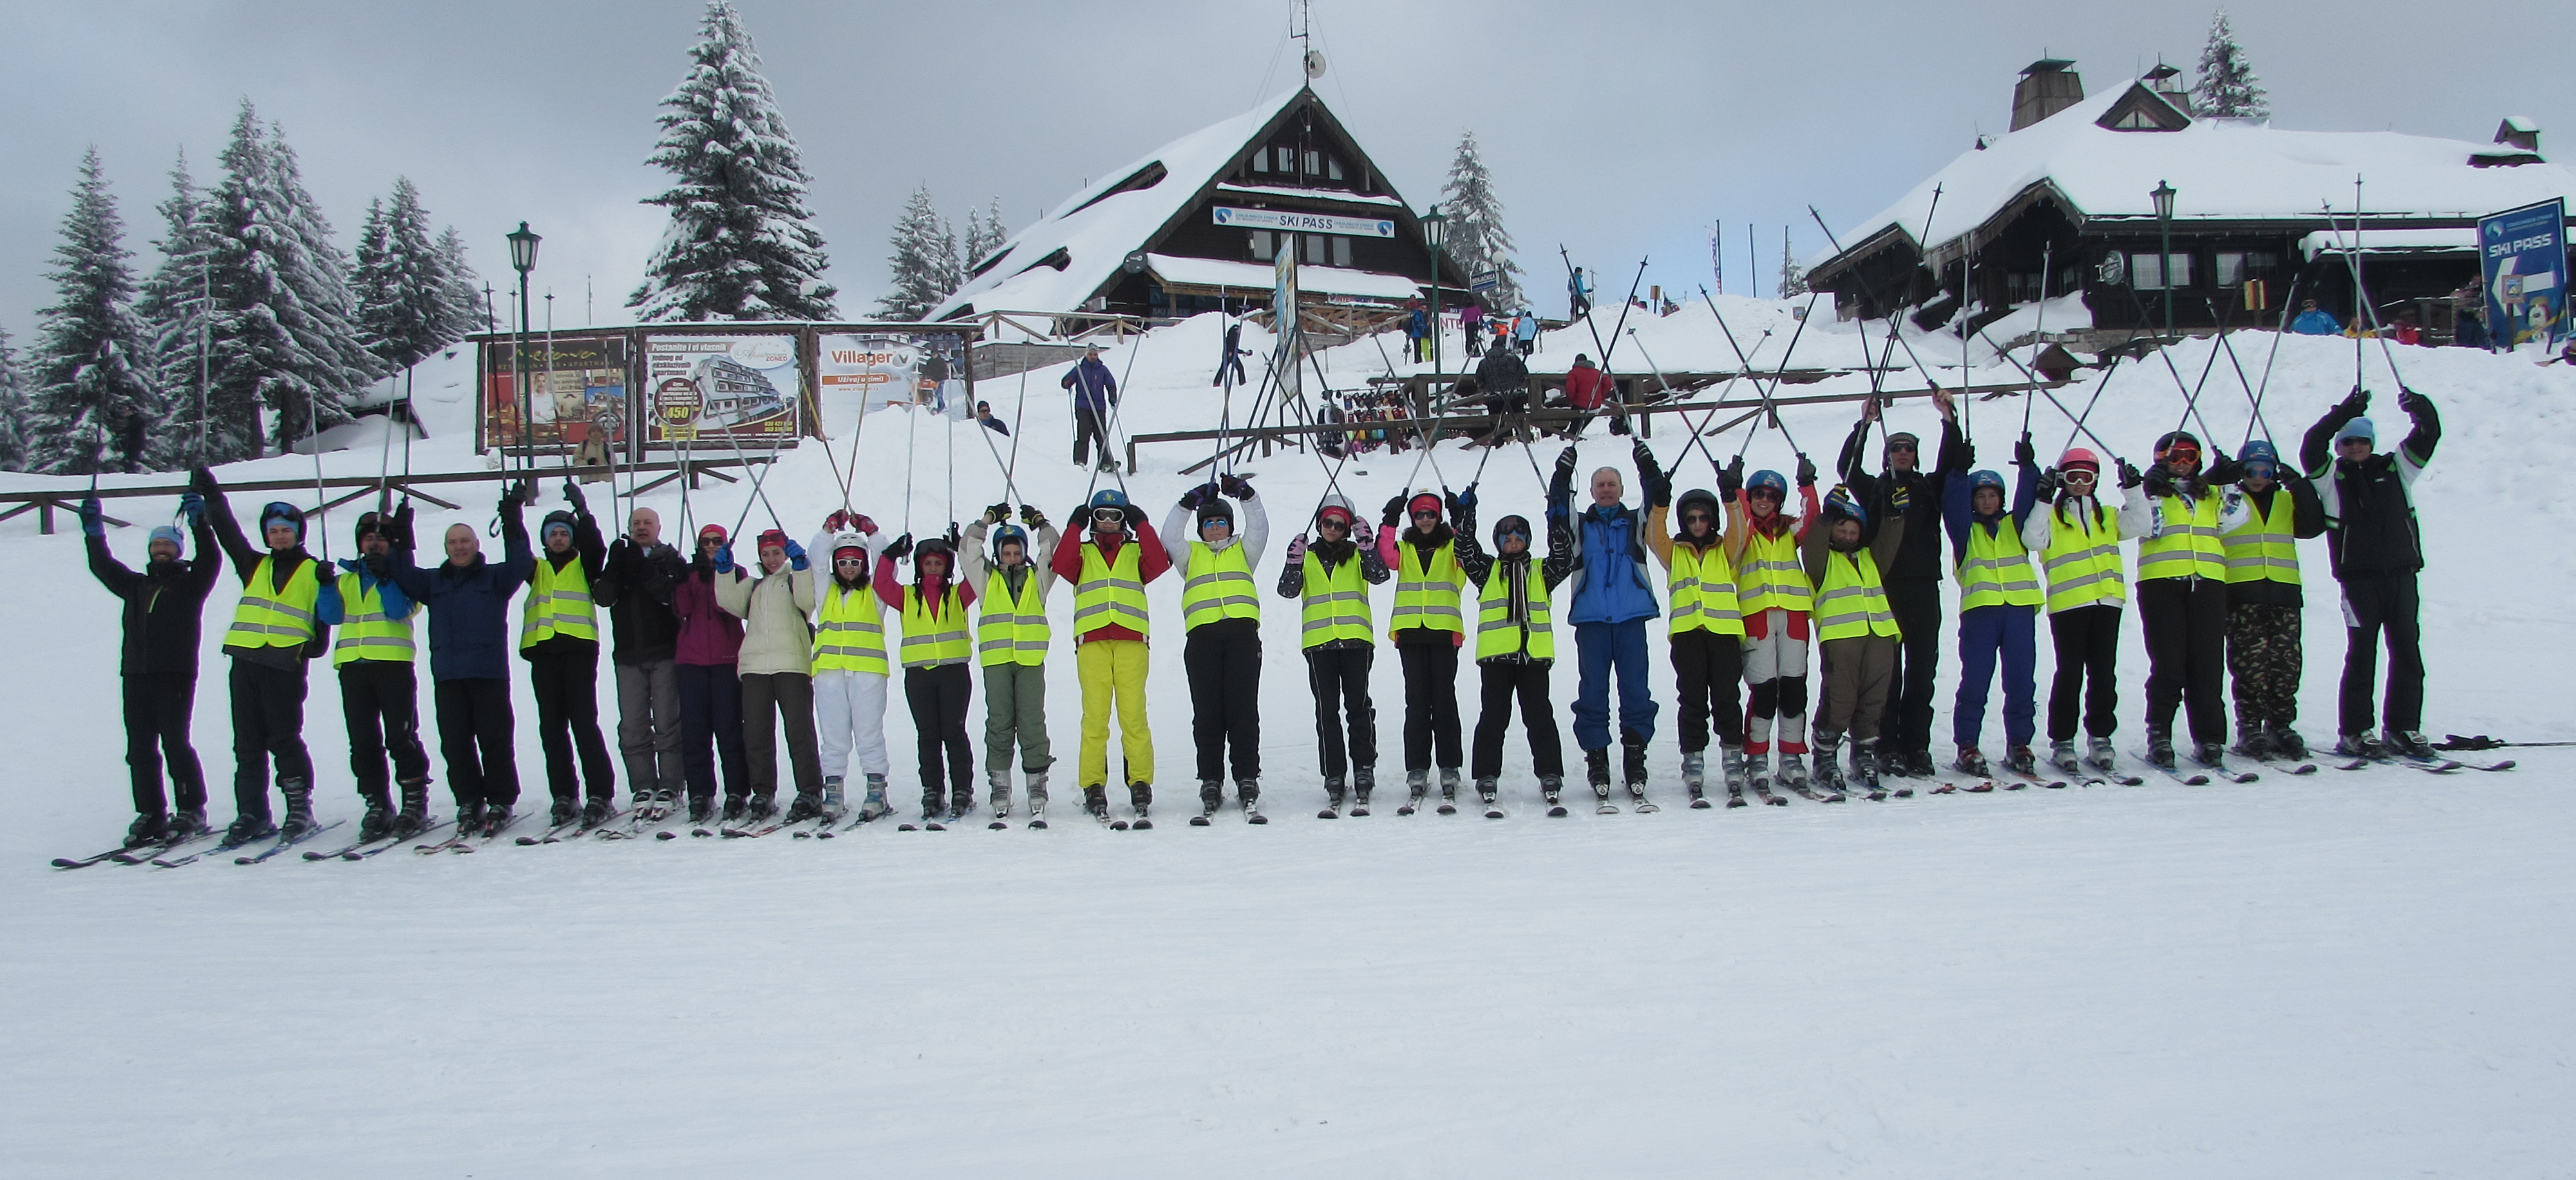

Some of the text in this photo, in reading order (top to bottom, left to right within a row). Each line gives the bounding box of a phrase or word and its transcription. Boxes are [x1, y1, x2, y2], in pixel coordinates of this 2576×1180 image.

[1279, 214, 1334, 230] SKI PASS
[2488, 233, 2552, 258] SKI PASS
[831, 350, 893, 366] Villager
